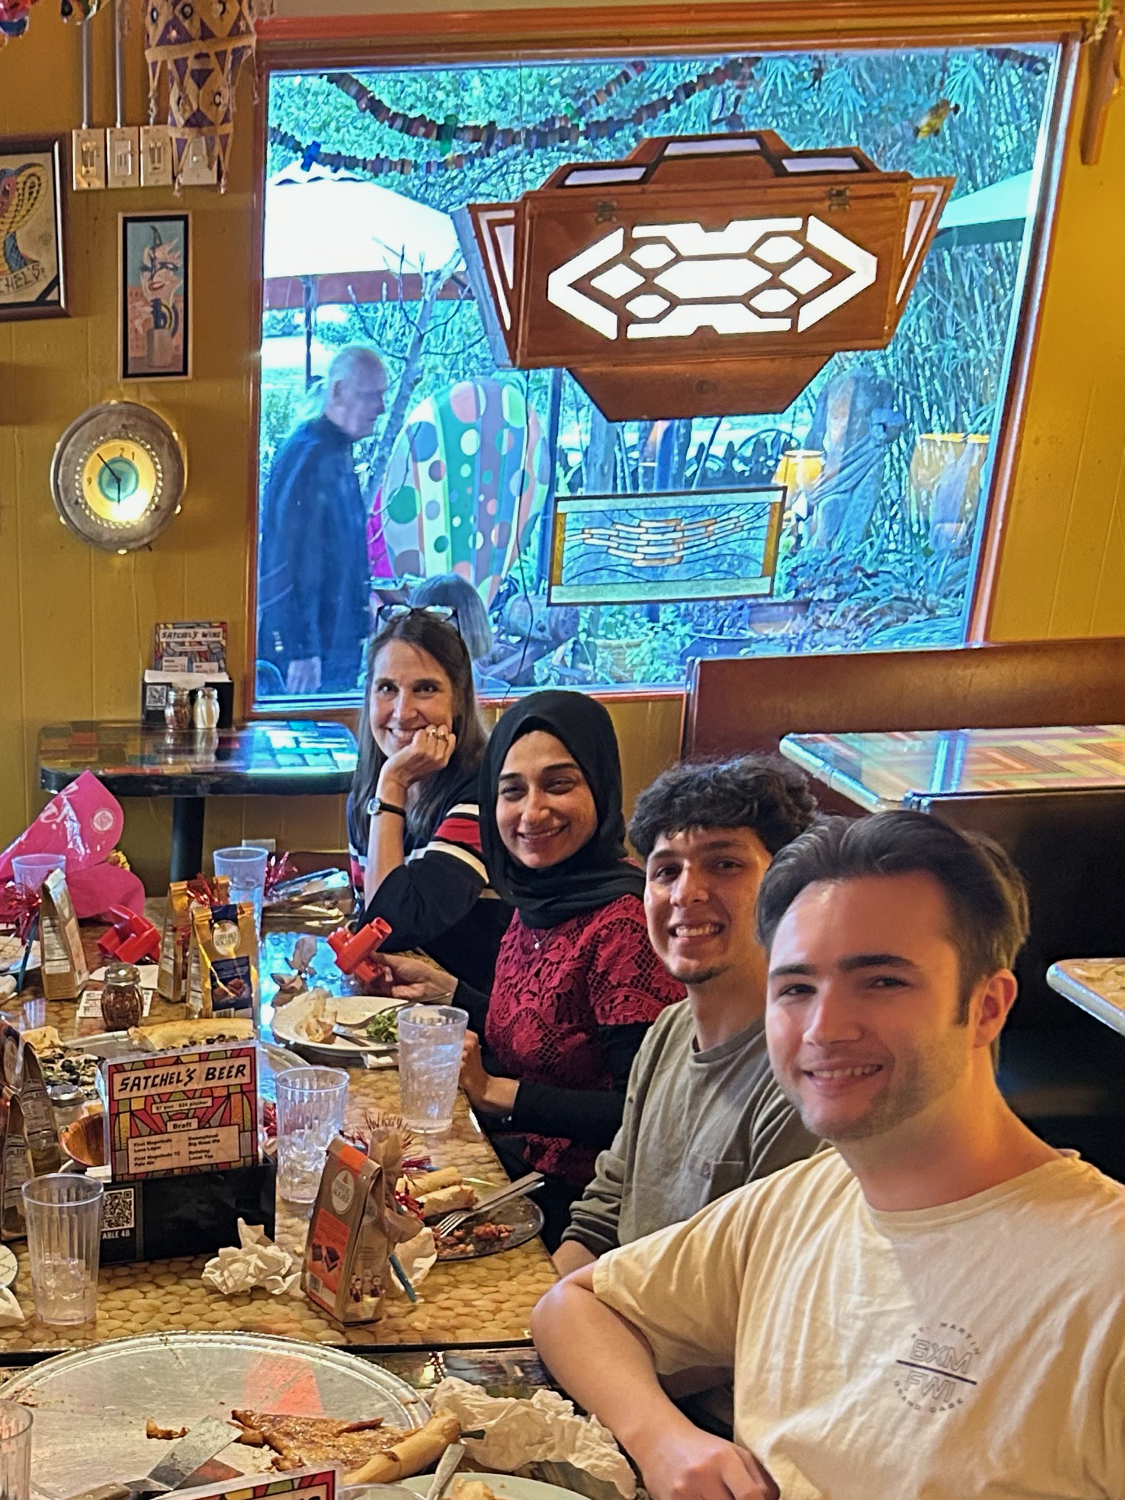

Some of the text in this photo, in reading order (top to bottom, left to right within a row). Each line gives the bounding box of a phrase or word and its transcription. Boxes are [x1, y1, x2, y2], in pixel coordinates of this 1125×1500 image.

[119, 1064, 247, 1092] SATCHEL'S BEER
[173, 1122, 193, 1130] Draft
[940, 1322, 981, 1356] MARTIN
[904, 1370, 957, 1403] FWI
